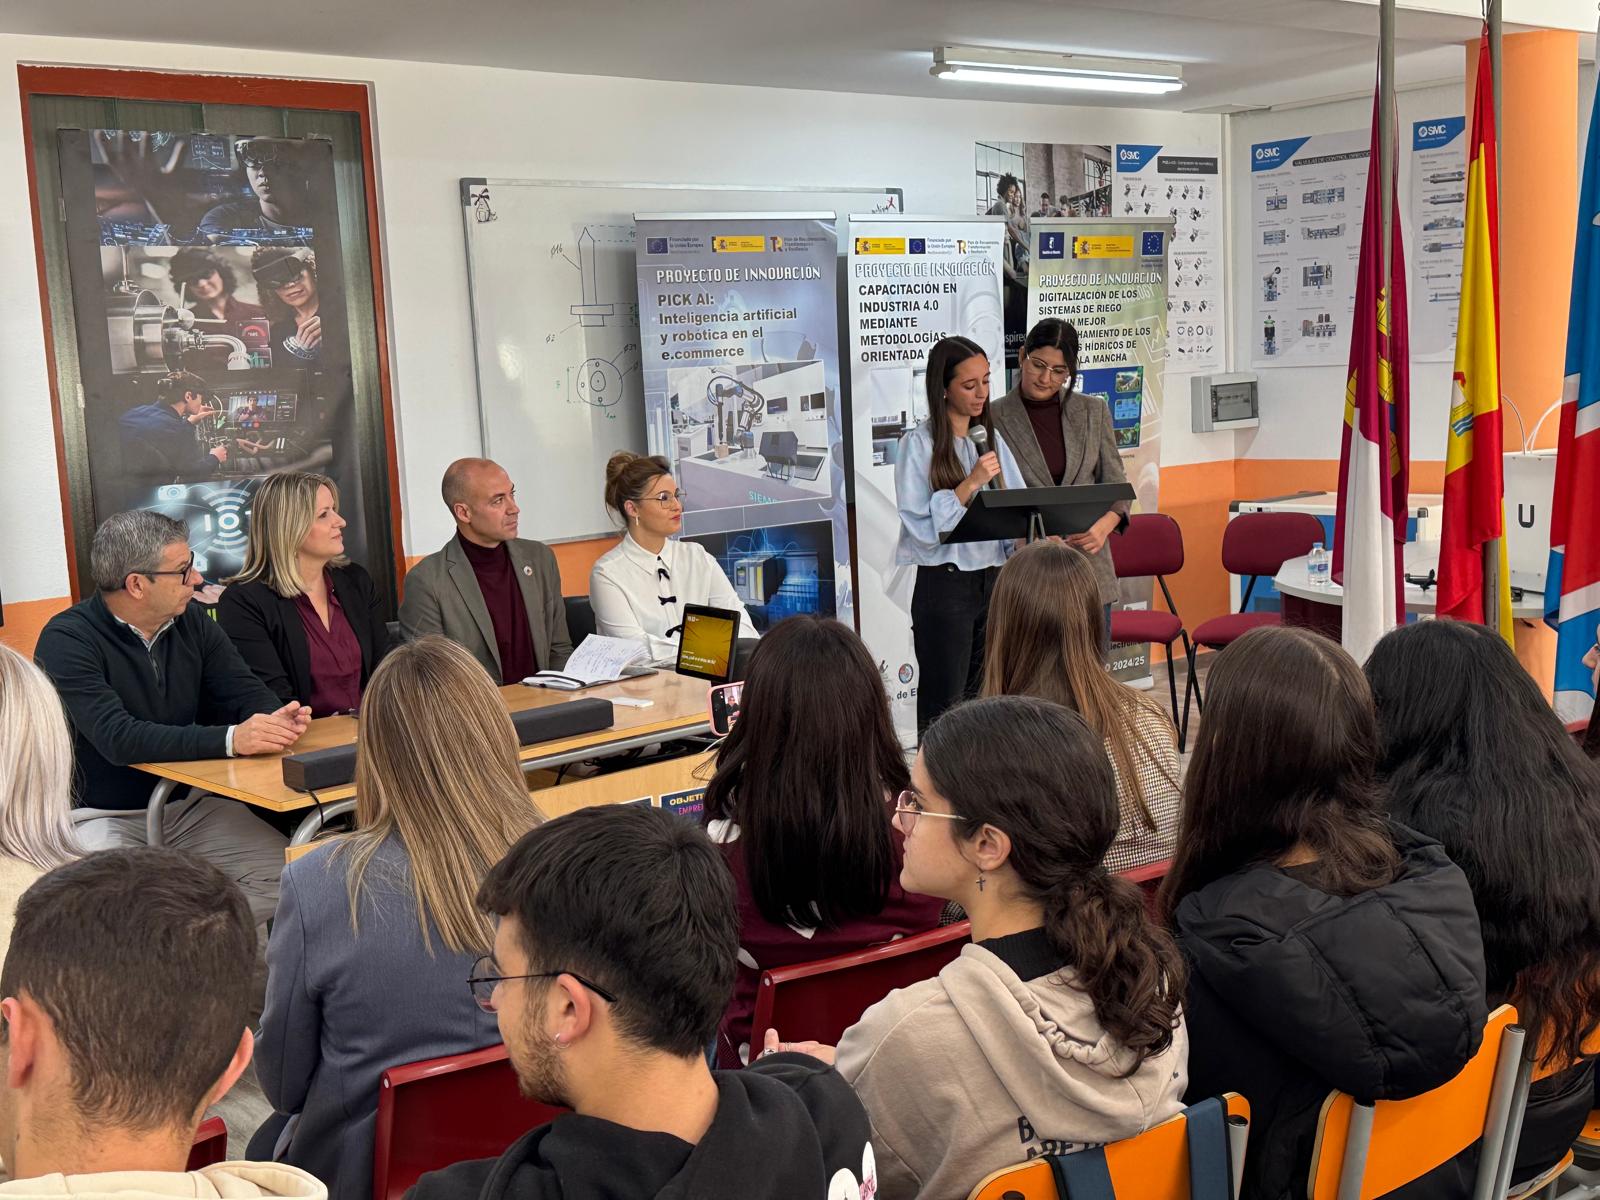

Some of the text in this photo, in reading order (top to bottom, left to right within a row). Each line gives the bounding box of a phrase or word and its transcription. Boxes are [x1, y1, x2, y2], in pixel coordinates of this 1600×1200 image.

[1428, 124, 1446, 135] SMC
[1126, 151, 1140, 160] SMC
[1264, 147, 1280, 158] SMC
[656, 263, 821, 284] PROYECTO DE INNOVACIÓN
[855, 259, 996, 278] PROYECTO DE INNOVACIÓN
[1039, 273, 1087, 287] PROYECTO
[1089, 273, 1101, 285] DE
[859, 281, 957, 296] CAPACITACIÓN EN
[658, 292, 715, 307] PICK AI:
[1039, 289, 1106, 302] DIGITALIZACIÓN
[1109, 290, 1120, 299] DE
[1121, 290, 1138, 298] LOS
[859, 300, 939, 313] INDUSTRIA 4.0
[1038, 304, 1122, 315] SISTEMAS DE RIEGO
[659, 308, 797, 326] Inteligencia artificial
[860, 317, 917, 329] MEDIANTE
[1077, 316, 1106, 326] MEJOR
[660, 327, 763, 345] y robótica en el
[860, 330, 946, 346] METODOLOGÍAS
[1077, 327, 1151, 339] HAMIENTO DE LOS
[1085, 340, 1124, 351] HÍDRICOS
[1126, 340, 1137, 349] DE
[661, 347, 745, 361] e.commerce
[861, 350, 925, 362] ORIENTADA
[1092, 353, 1127, 363] MANCHA
[1517, 503, 1535, 528] U
[1112, 656, 1145, 671] 2024/25
[896, 690, 908, 700] de
[669, 792, 704, 806] OBJETI
[678, 803, 704, 816] EMPRE
